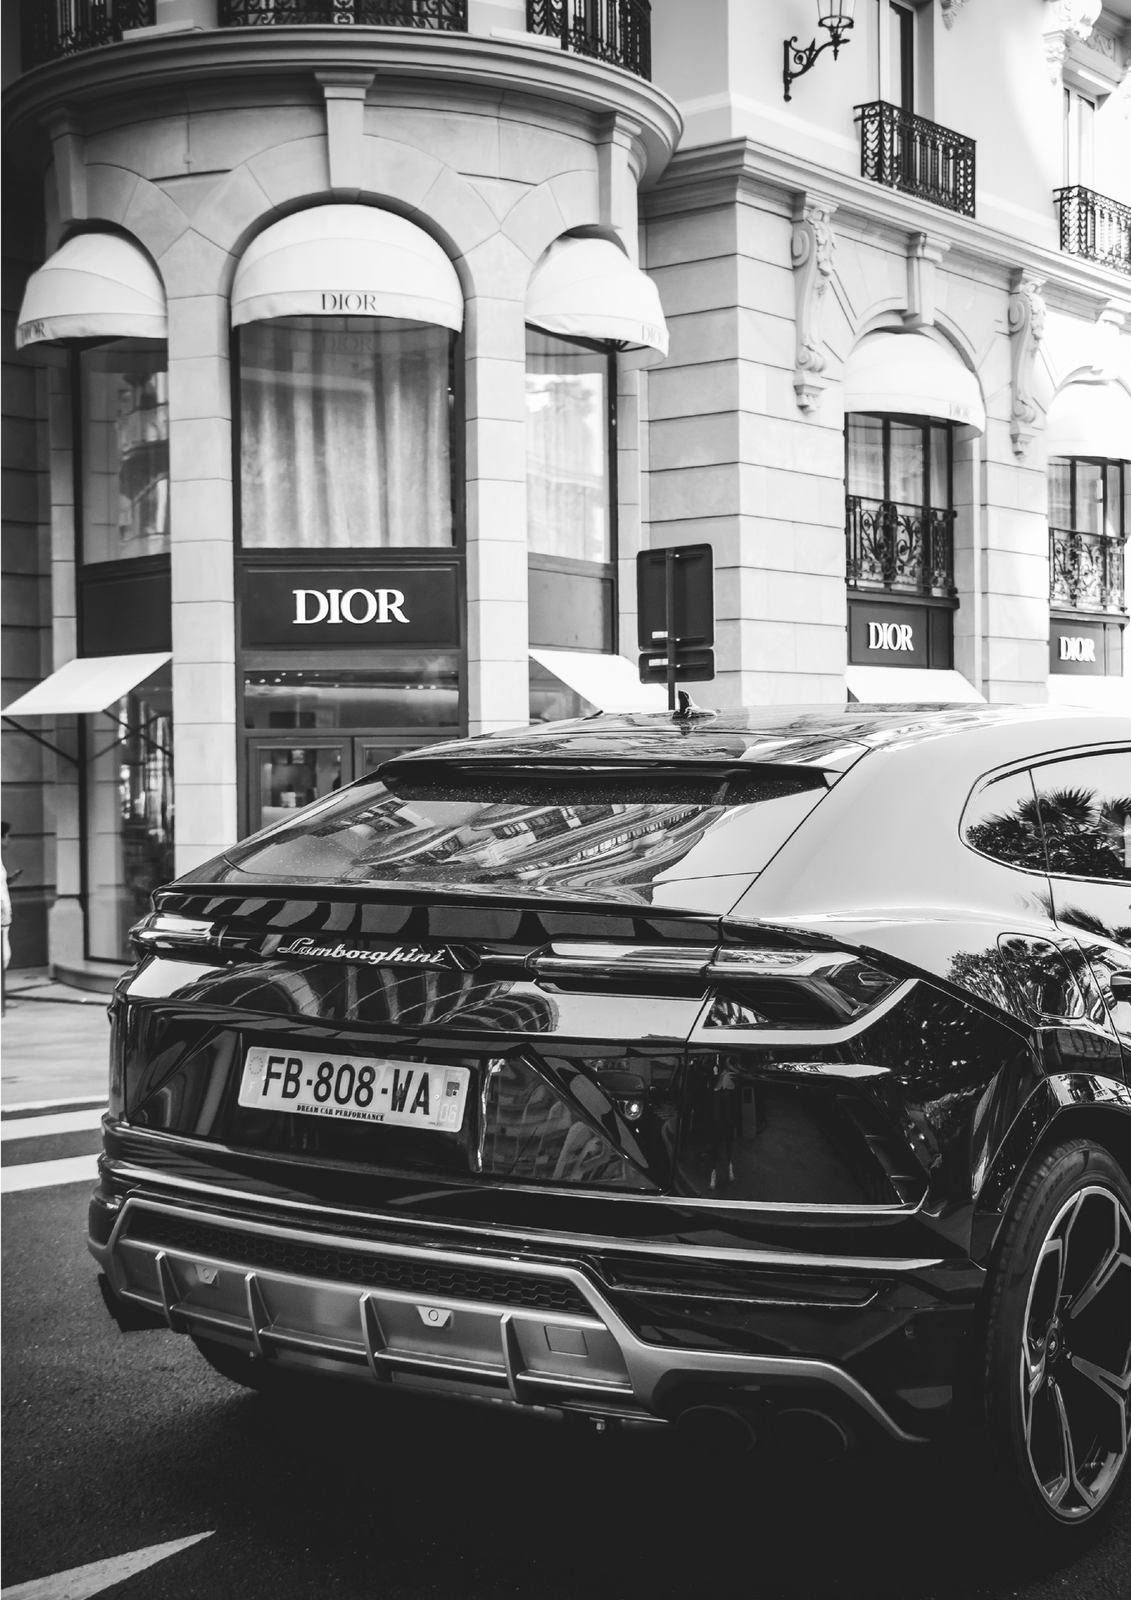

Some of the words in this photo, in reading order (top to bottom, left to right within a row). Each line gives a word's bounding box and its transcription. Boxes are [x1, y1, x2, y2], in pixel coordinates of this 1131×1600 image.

[321, 293, 378, 312] DIOR
[21, 321, 47, 340] OR
[641, 324, 664, 346] DIO
[292, 588, 411, 624] DIOR
[867, 621, 915, 652] DIOR
[1059, 636, 1097, 663] DIOR
[277, 937, 446, 965] Lamborghini
[296, 1104, 319, 1114] DREAM
[320, 1106, 333, 1116] CAR
[335, 1108, 385, 1122] PERFORMANCE
